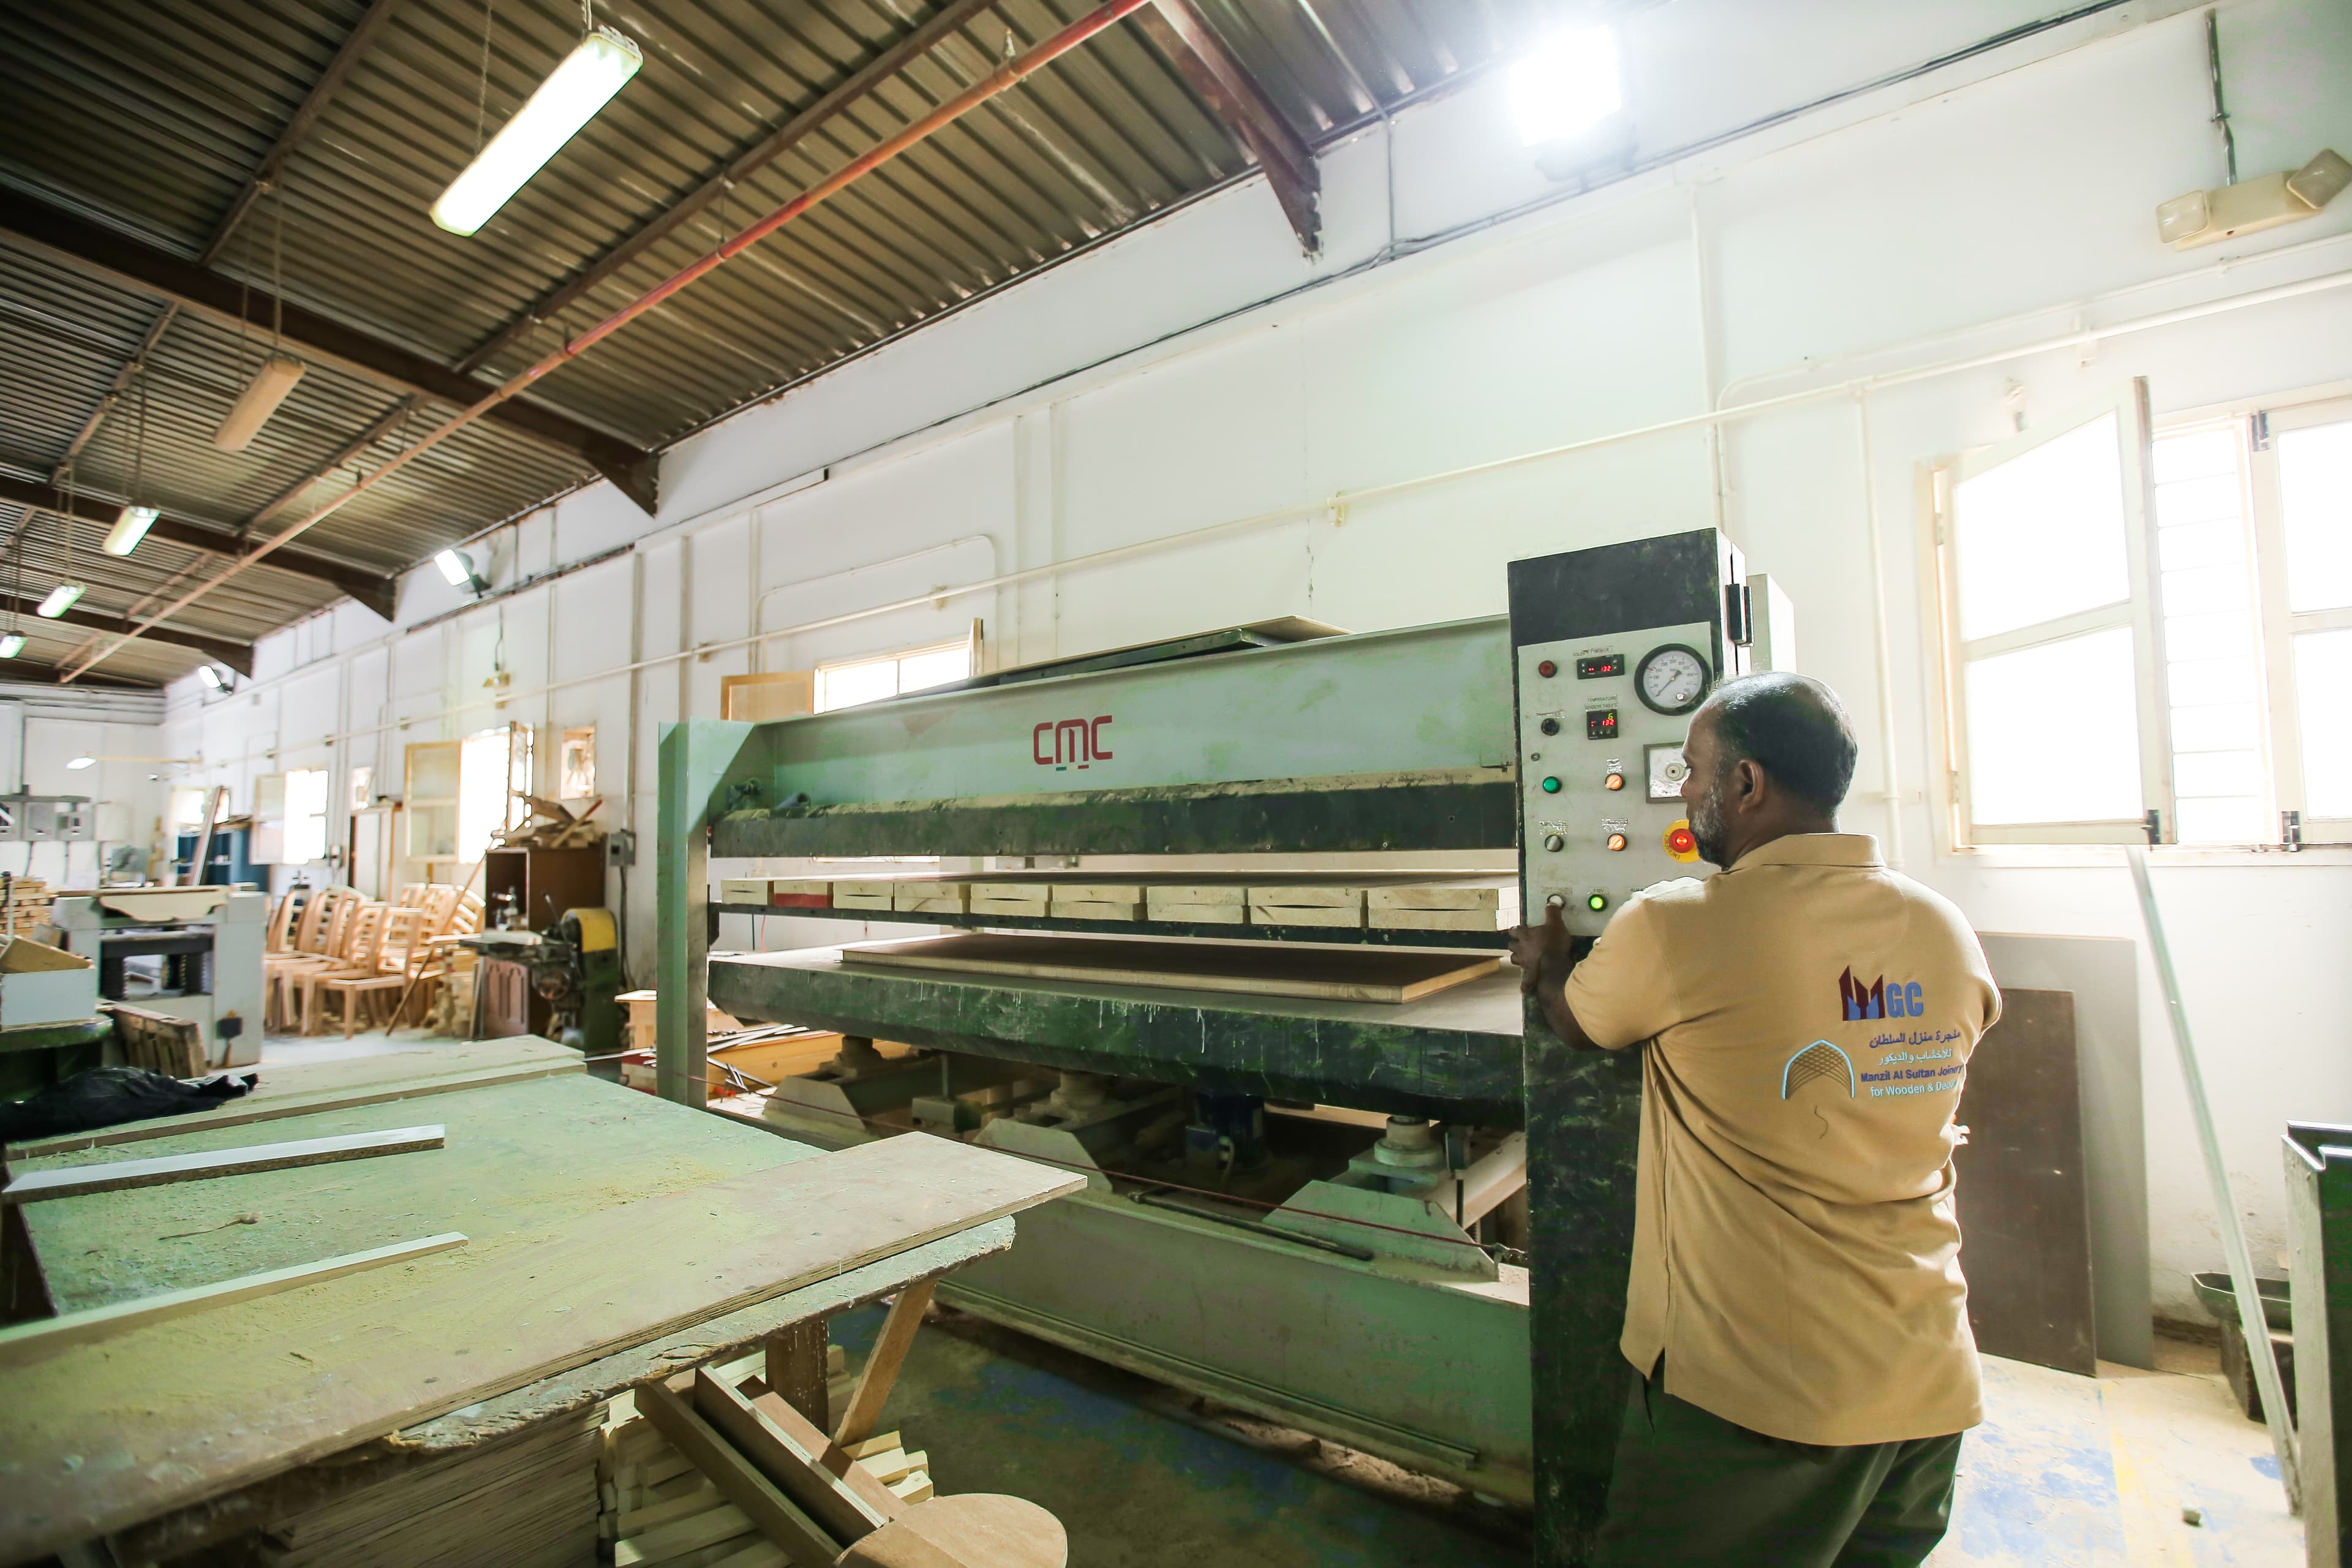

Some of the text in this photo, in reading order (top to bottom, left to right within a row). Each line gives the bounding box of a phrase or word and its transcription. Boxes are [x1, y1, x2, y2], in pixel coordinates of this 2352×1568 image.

[1033, 715, 1113, 765] CMC
[1869, 1032, 1905, 1048] السلطان
[1909, 1031, 1933, 1045] منزل
[1861, 1065, 1963, 1082] Manzil Al Sultan Joinery
[1870, 1086, 1884, 1097] for
[1886, 1084, 1925, 1096] Wooden
[1928, 1083, 1934, 1093] &
